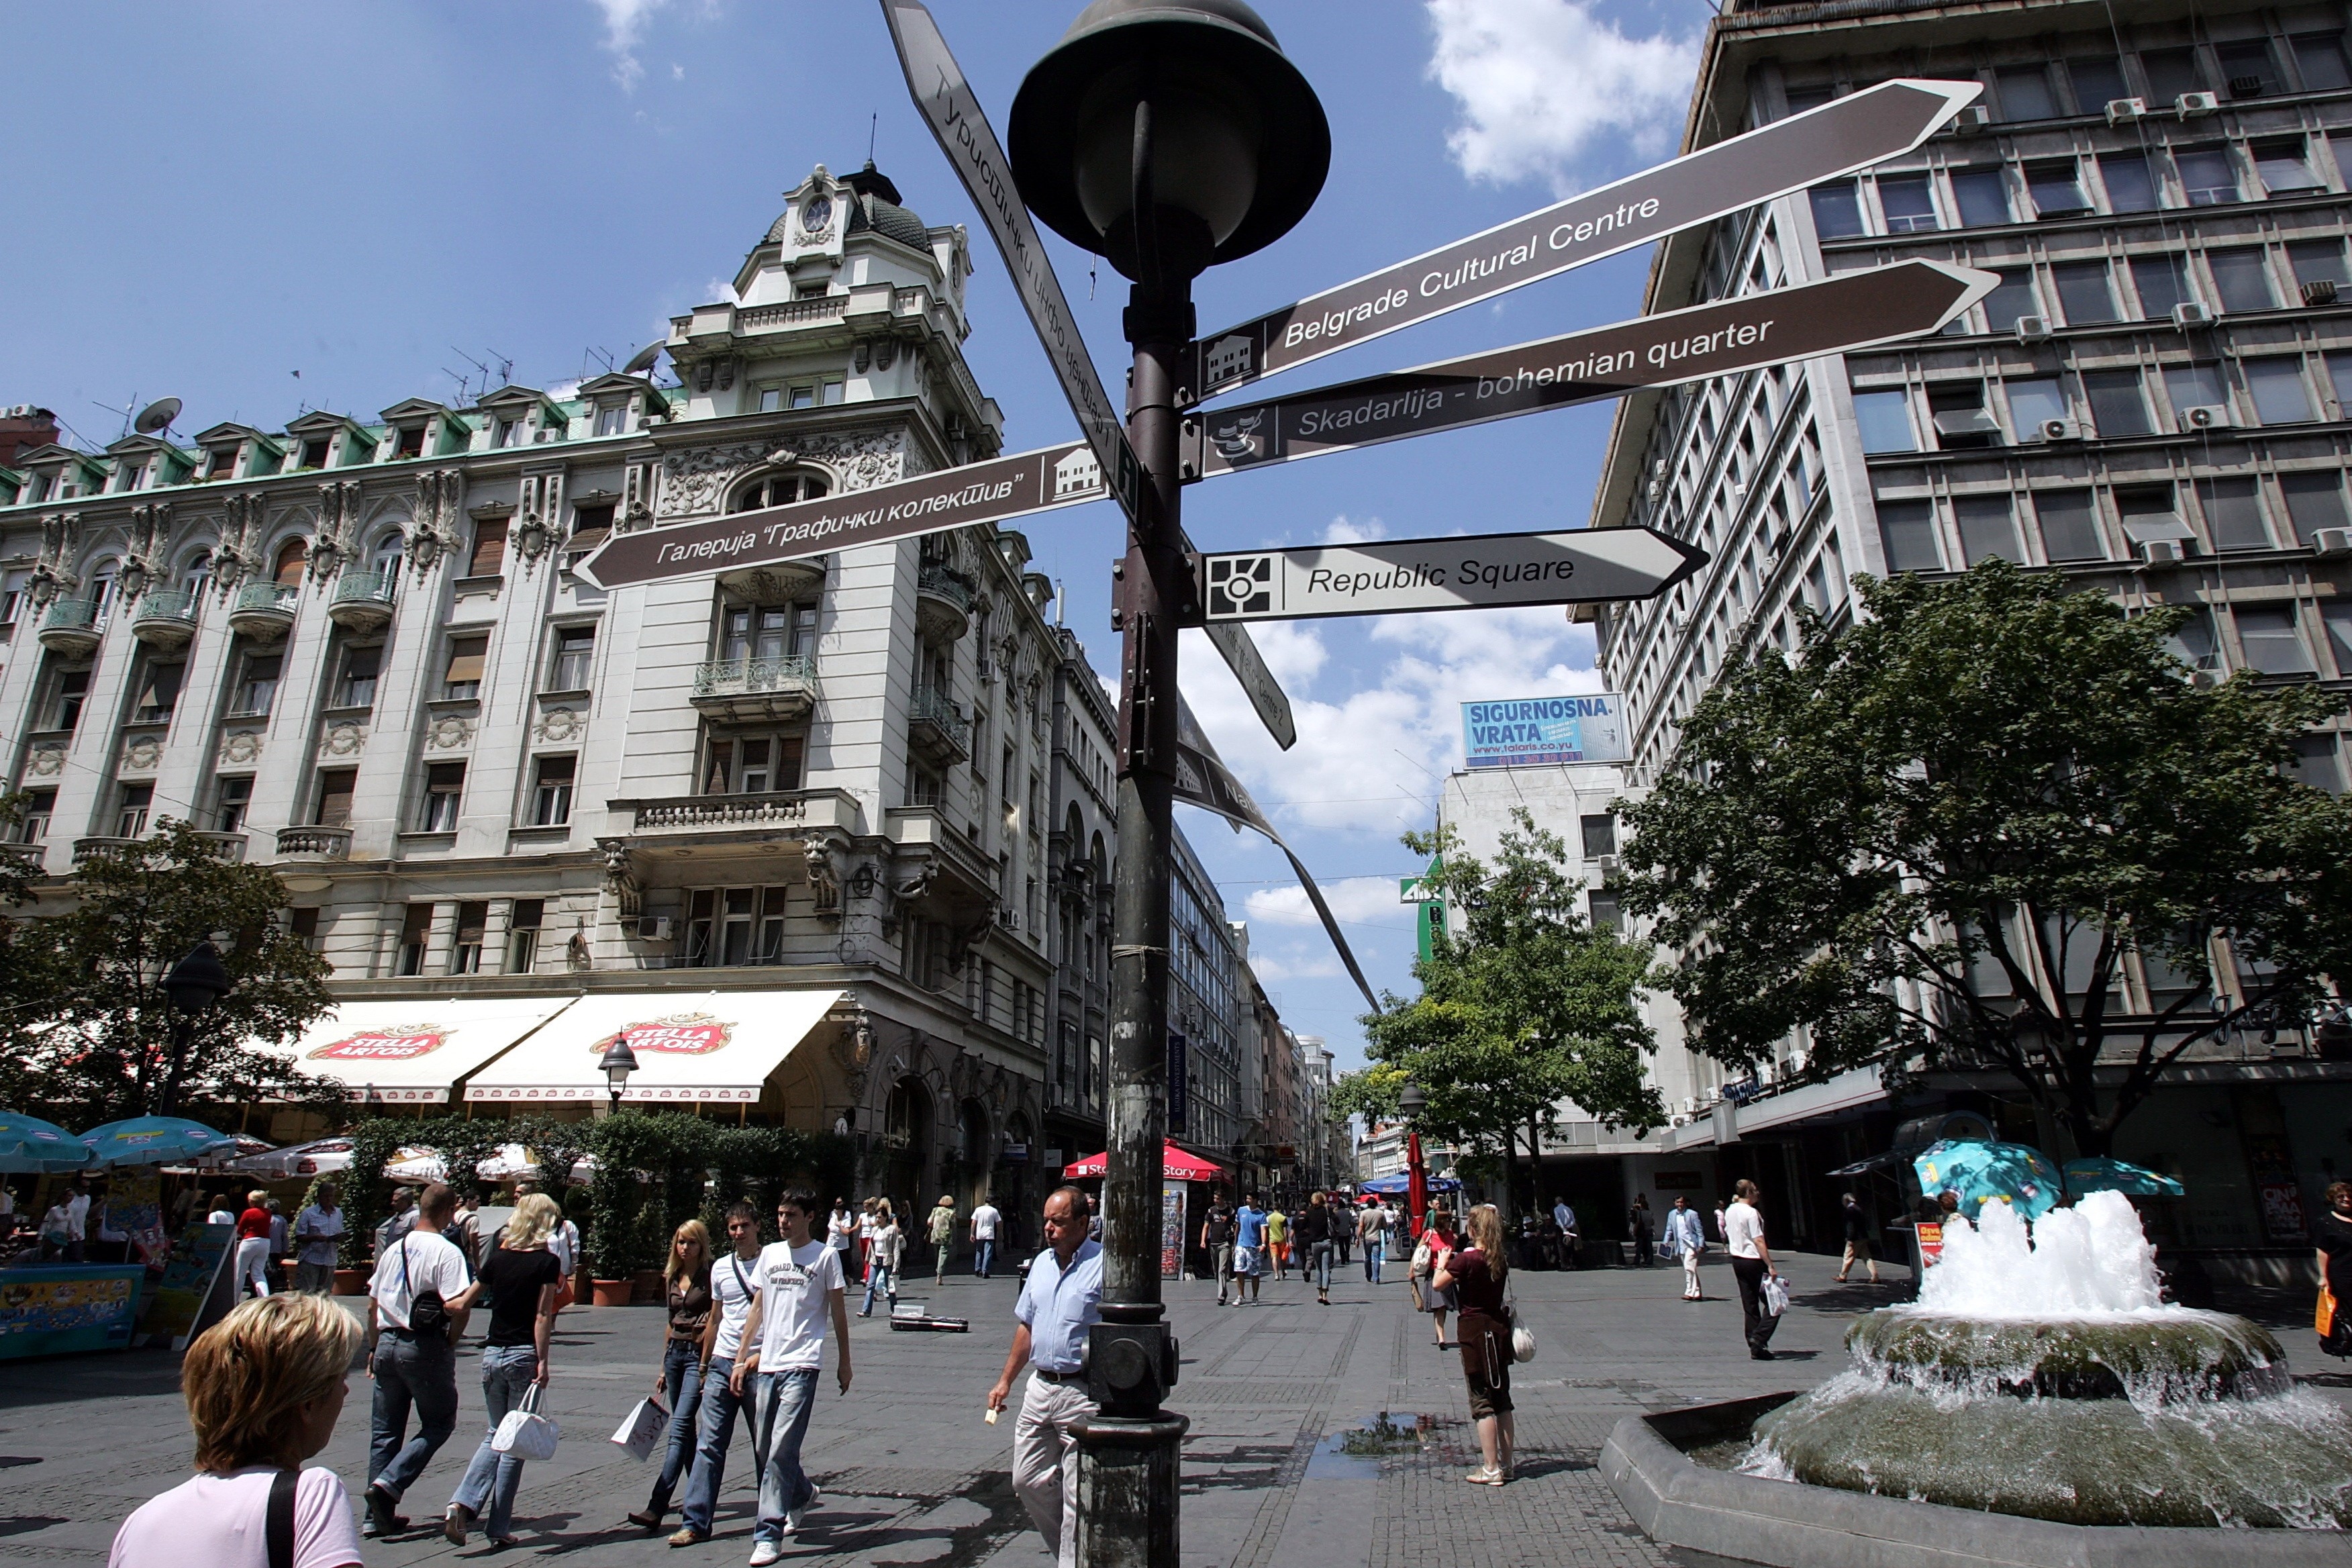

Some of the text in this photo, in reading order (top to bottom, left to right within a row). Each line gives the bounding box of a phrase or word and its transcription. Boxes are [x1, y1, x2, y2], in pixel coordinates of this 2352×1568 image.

[1285, 197, 1660, 348] Belgrade Cultural Centre
[1034, 273, 1065, 348] инфо
[1065, 347, 1104, 434] центар
[1298, 387, 1443, 436] Skadarlija
[1476, 349, 1636, 399] bohemian
[1648, 320, 1773, 369] quarter
[657, 532, 756, 564] Галерија
[1308, 560, 1575, 597] Republic Square
[1226, 624, 1283, 726] Informaton Centre 2
[1470, 698, 1608, 723] SIGURNOSNA
[1473, 723, 1541, 744] VRATA
[350, 1038, 430, 1047] STELLA
[628, 1028, 711, 1040] STELLA
[332, 1047, 419, 1056] ARTOIS
[1163, 1165, 1196, 1178] Story
[765, 1263, 818, 1282] LOMBARD STREET
